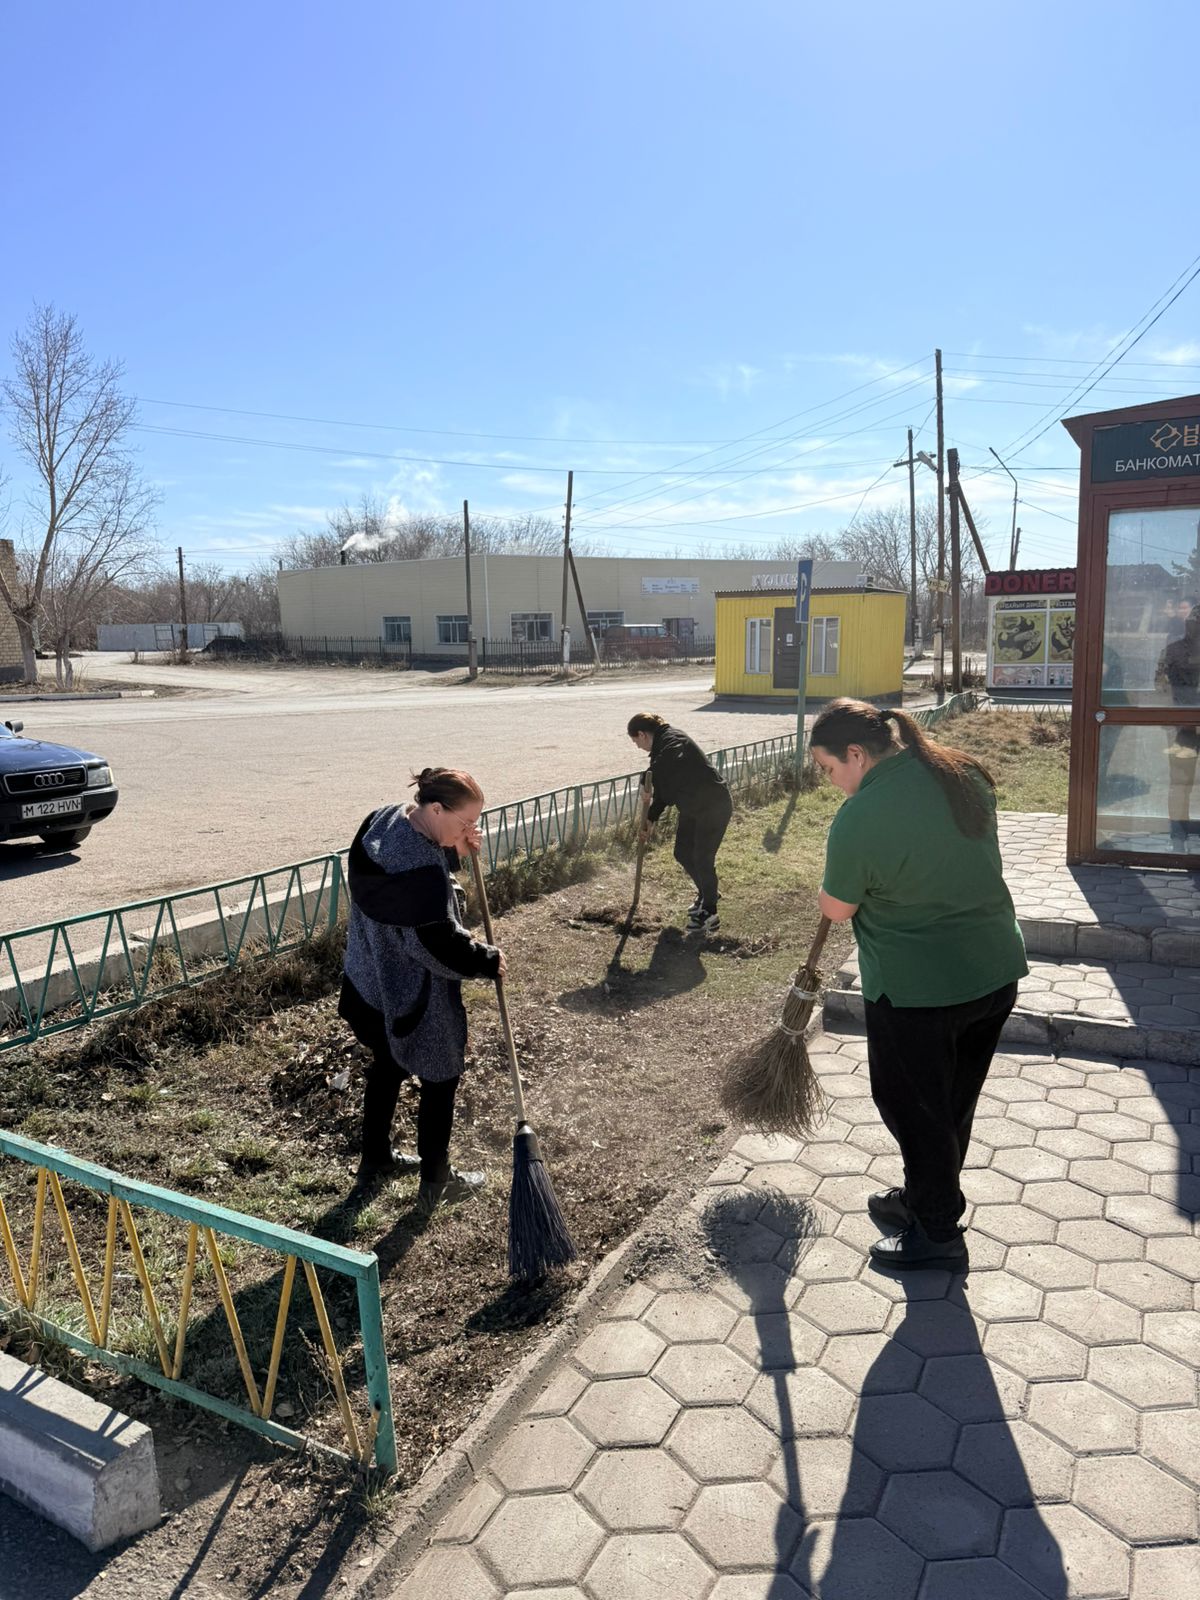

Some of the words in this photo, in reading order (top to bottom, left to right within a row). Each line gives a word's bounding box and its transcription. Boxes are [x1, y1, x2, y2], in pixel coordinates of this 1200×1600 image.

[1115, 453, 1200, 472] БАНКОМАТ
[986, 572, 1076, 593] DONER
[25, 805, 34, 817] M
[37, 802, 55, 815] 122
[57, 800, 79, 812] HVN
